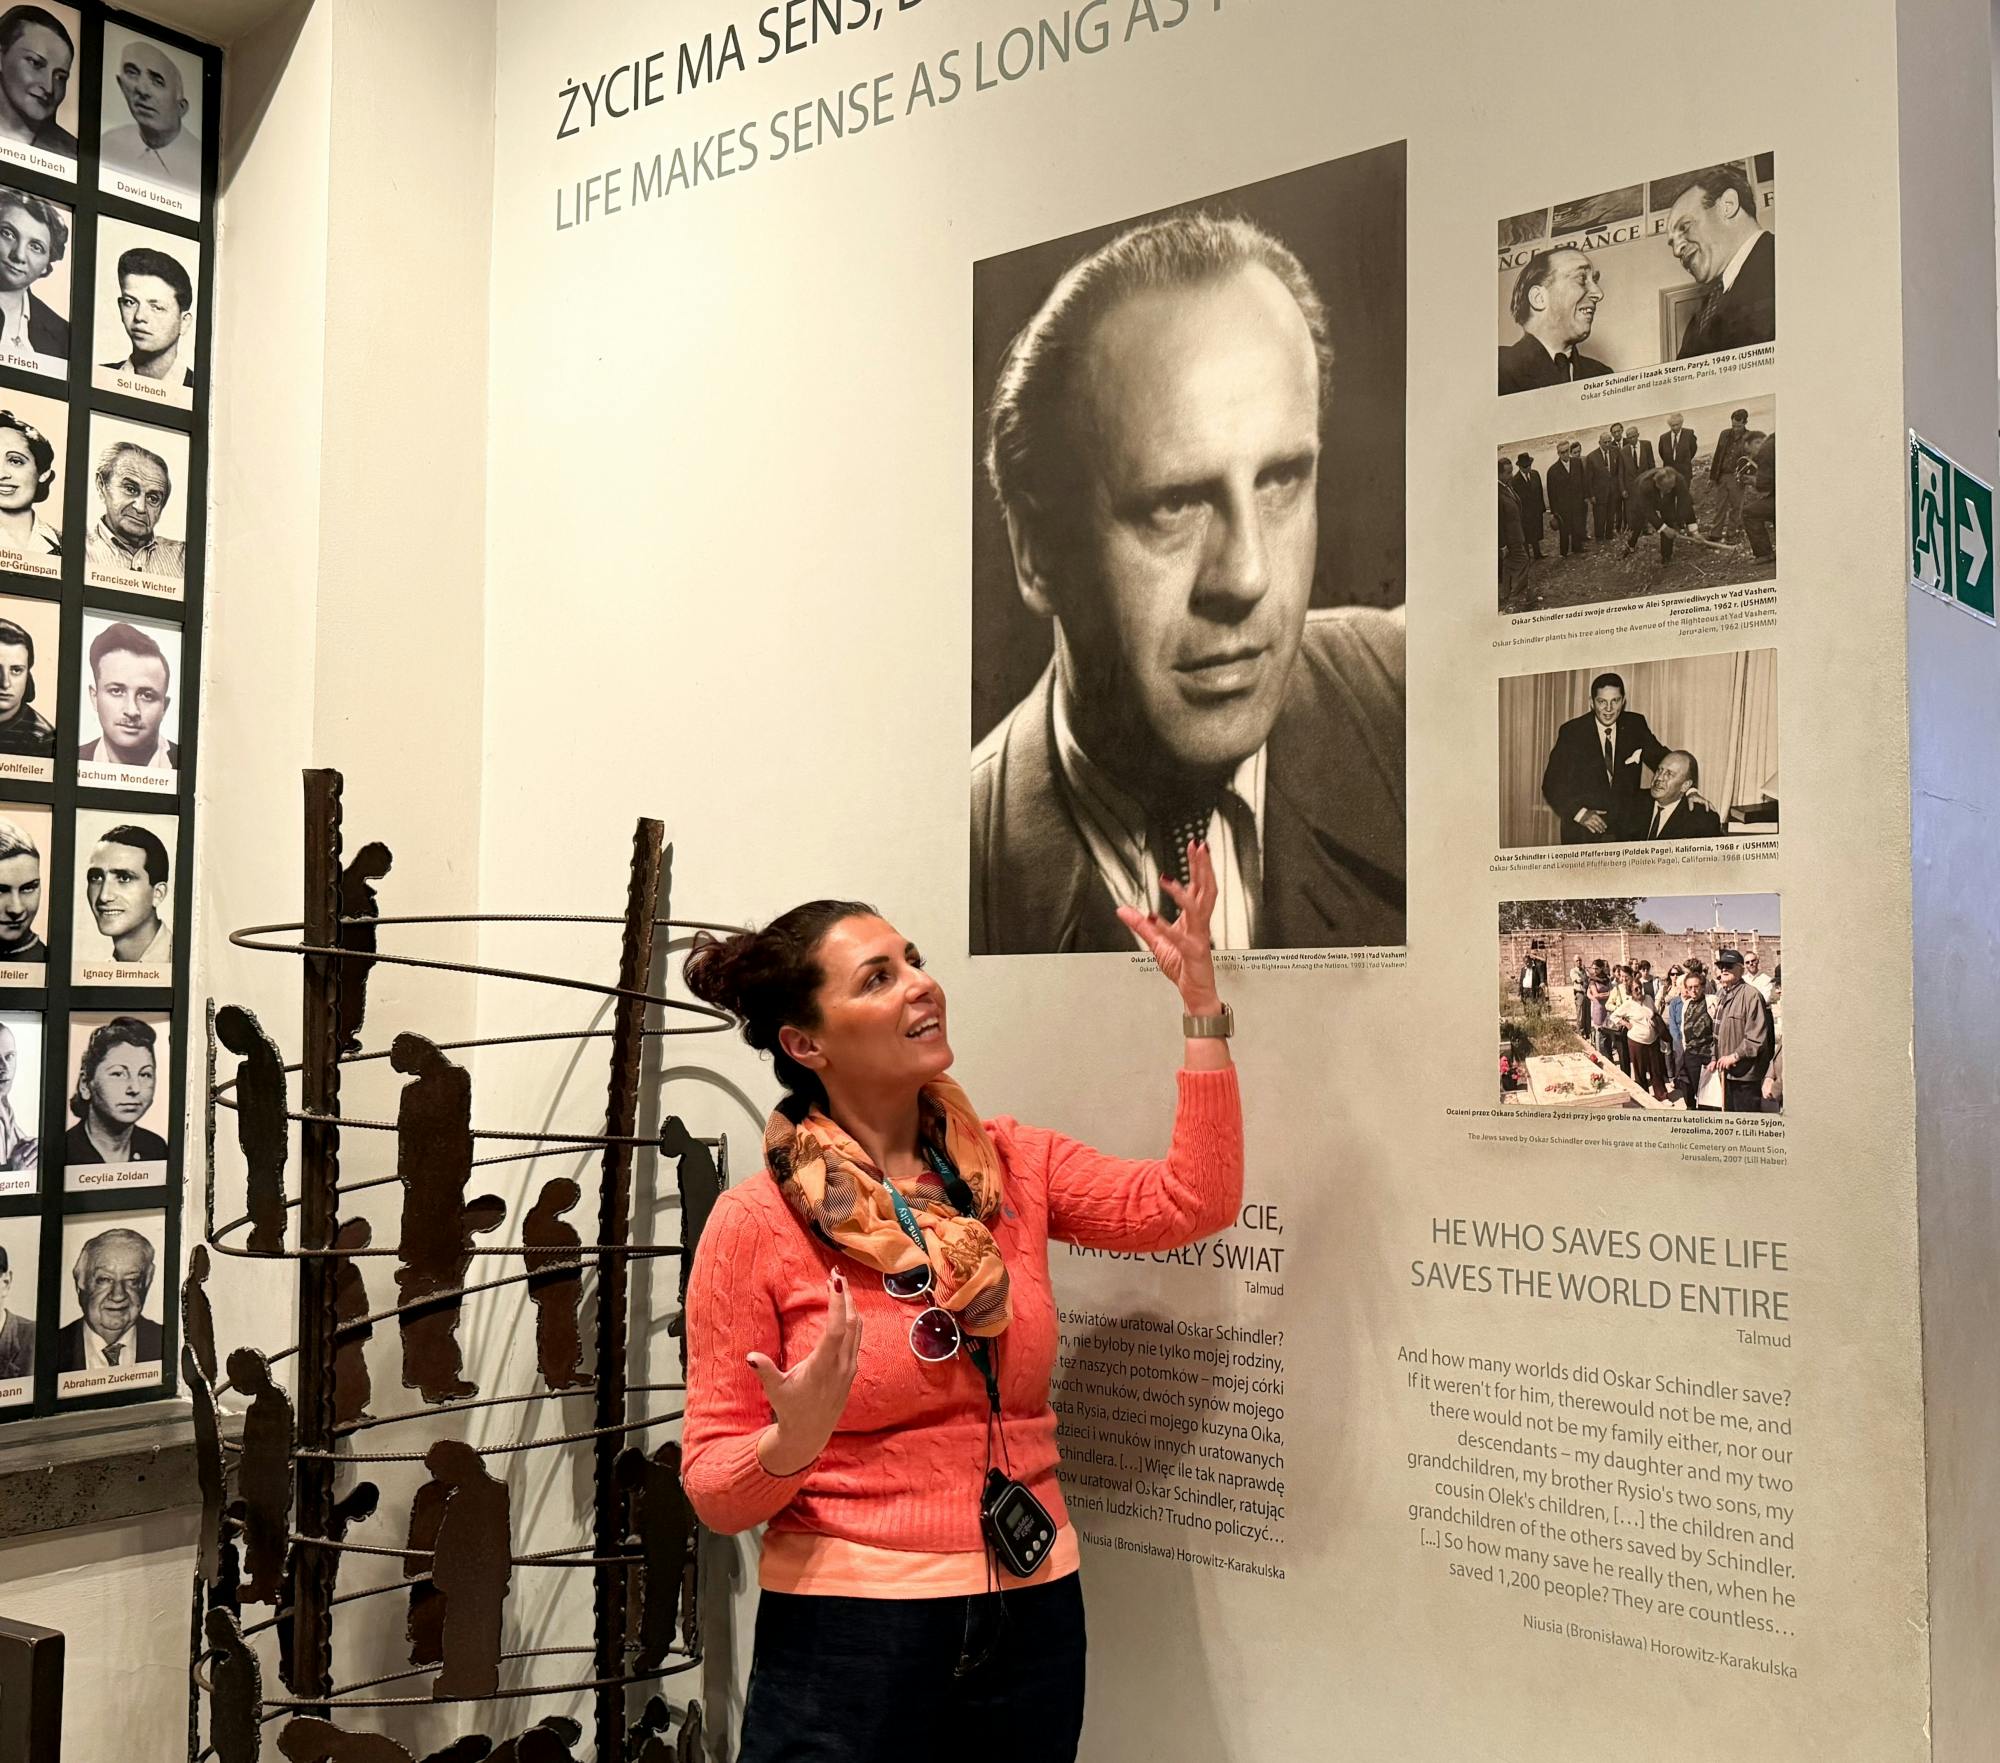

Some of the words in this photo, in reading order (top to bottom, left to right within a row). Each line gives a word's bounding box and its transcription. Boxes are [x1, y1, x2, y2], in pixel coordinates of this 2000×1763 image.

[556, 51, 666, 141] ŻYCIE
[676, 22, 746, 96] MA
[556, 167, 622, 232] LIFE
[631, 121, 759, 207] MAKES
[769, 71, 895, 161] SENSE
[904, 49, 962, 116] AS
[975, 0, 1110, 93] LONG
[1123, 0, 1190, 43] AS
[29, 154, 66, 174] Urbach
[116, 180, 147, 198] Dawid
[149, 191, 183, 210] Urbach
[7, 354, 39, 370] Frisch
[116, 378, 132, 390] Sol
[134, 382, 167, 398] Urbach
[0, 548, 23, 562] bina
[90, 571, 140, 588] Franciszek
[140, 579, 177, 594] Wichter
[120, 772, 170, 787] Monderer
[82, 968, 114, 981] Ignacy
[115, 968, 160, 980] Birmhack
[78, 1172, 114, 1185] Cecylia
[116, 1170, 149, 1182] Zoldan
[1212, 1238, 1286, 1274] ŚWIAT
[1432, 1217, 1468, 1247] HE
[1471, 1219, 1545, 1252] WHO
[1551, 1225, 1642, 1263] SAVES
[1648, 1232, 1718, 1266] ONE
[1725, 1238, 1789, 1272] LIFE
[1244, 1280, 1284, 1297] Talmud
[1410, 1260, 1493, 1294] SAVES
[1496, 1267, 1553, 1300] THE
[1556, 1271, 1672, 1310] WORLD
[1680, 1282, 1790, 1322] ENTIRE
[1068, 1309, 1118, 1328] światów
[1176, 1320, 1215, 1340] Oskar
[1215, 1324, 1284, 1347] Schindler?
[1735, 1328, 1792, 1349] Talmud
[1193, 1347, 1230, 1369] mojej
[1232, 1351, 1284, 1375] rodziny,
[1397, 1345, 1428, 1364] And
[1431, 1348, 1466, 1369] how
[1468, 1356, 1512, 1381] many
[1514, 1360, 1570, 1381] worlds
[1572, 1364, 1600, 1385] did
[1602, 1368, 1652, 1393] Oskar
[1655, 1374, 1739, 1401] Schindler
[1742, 1388, 1792, 1408] save?
[62, 1376, 107, 1390] Abraham
[107, 1370, 159, 1384] Zuckerman
[1188, 1395, 1231, 1413] synów
[1232, 1400, 1285, 1423] mojego
[1408, 1368, 1422, 1388] If
[1420, 1368, 1432, 1391] it
[1432, 1378, 1492, 1399] weren't
[1493, 1378, 1517, 1401] for
[1519, 1384, 1554, 1408] him,
[1557, 1388, 1655, 1419] therewould
[1658, 1399, 1692, 1424] not
[1692, 1405, 1716, 1427] be
[1720, 1414, 1753, 1434] me,
[1756, 1417, 1792, 1436] and
[1098, 1430, 1152, 1449] wnuków
[1154, 1438, 1196, 1457] innych
[1198, 1445, 1284, 1471] uratowanych
[1428, 1399, 1471, 1422] there
[1472, 1408, 1523, 1430] would
[1526, 1416, 1554, 1433] not
[1557, 1415, 1579, 1436] be
[1581, 1424, 1610, 1444] my
[1608, 1422, 1664, 1452] family
[1666, 1429, 1722, 1458] either,
[1726, 1442, 1758, 1460] nor
[1761, 1447, 1794, 1465] our
[1457, 1428, 1558, 1462] descendants
[1574, 1450, 1600, 1470] my
[1603, 1449, 1686, 1481] daughter
[1686, 1464, 1721, 1483] and
[1726, 1470, 1754, 1492] my
[1756, 1472, 1794, 1493] two
[1407, 1452, 1519, 1484] grandchildren,
[1522, 1468, 1548, 1489] my
[1550, 1468, 1614, 1496] brother
[1617, 1475, 1676, 1508] Rysio's
[1676, 1488, 1715, 1513] two
[1713, 1497, 1762, 1520] sons,
[1766, 1504, 1794, 1526] my
[1106, 1498, 1164, 1522] ludzkich?
[1164, 1508, 1212, 1530] Trudno
[1434, 1482, 1485, 1505] cousin
[1488, 1486, 1538, 1511] Olek's
[1538, 1494, 1610, 1524] children,
[1648, 1511, 1679, 1533] the
[1682, 1513, 1755, 1546] children
[1758, 1531, 1794, 1551] and
[1082, 1530, 1112, 1548] Niusia
[1114, 1536, 1176, 1561] (Bronisława)
[1176, 1547, 1286, 1580] Horowitz-Karakulska
[1408, 1504, 1516, 1534] grandchildren
[1519, 1518, 1538, 1537] of
[1538, 1520, 1567, 1542] the
[1569, 1527, 1626, 1552] others
[1624, 1530, 1677, 1562] saved
[1680, 1543, 1703, 1568] by
[1706, 1543, 1796, 1580] Schindler.
[1448, 1559, 1494, 1583] saved
[1498, 1567, 1543, 1591] 1,200
[1541, 1572, 1610, 1604] people?
[1610, 1584, 1654, 1615] They
[1657, 1599, 1685, 1617] are
[1523, 1613, 1564, 1635] Niusia
[1566, 1621, 1648, 1652] (Bronisława)
[1650, 1638, 1798, 1679] Horowitz-Karakulska
